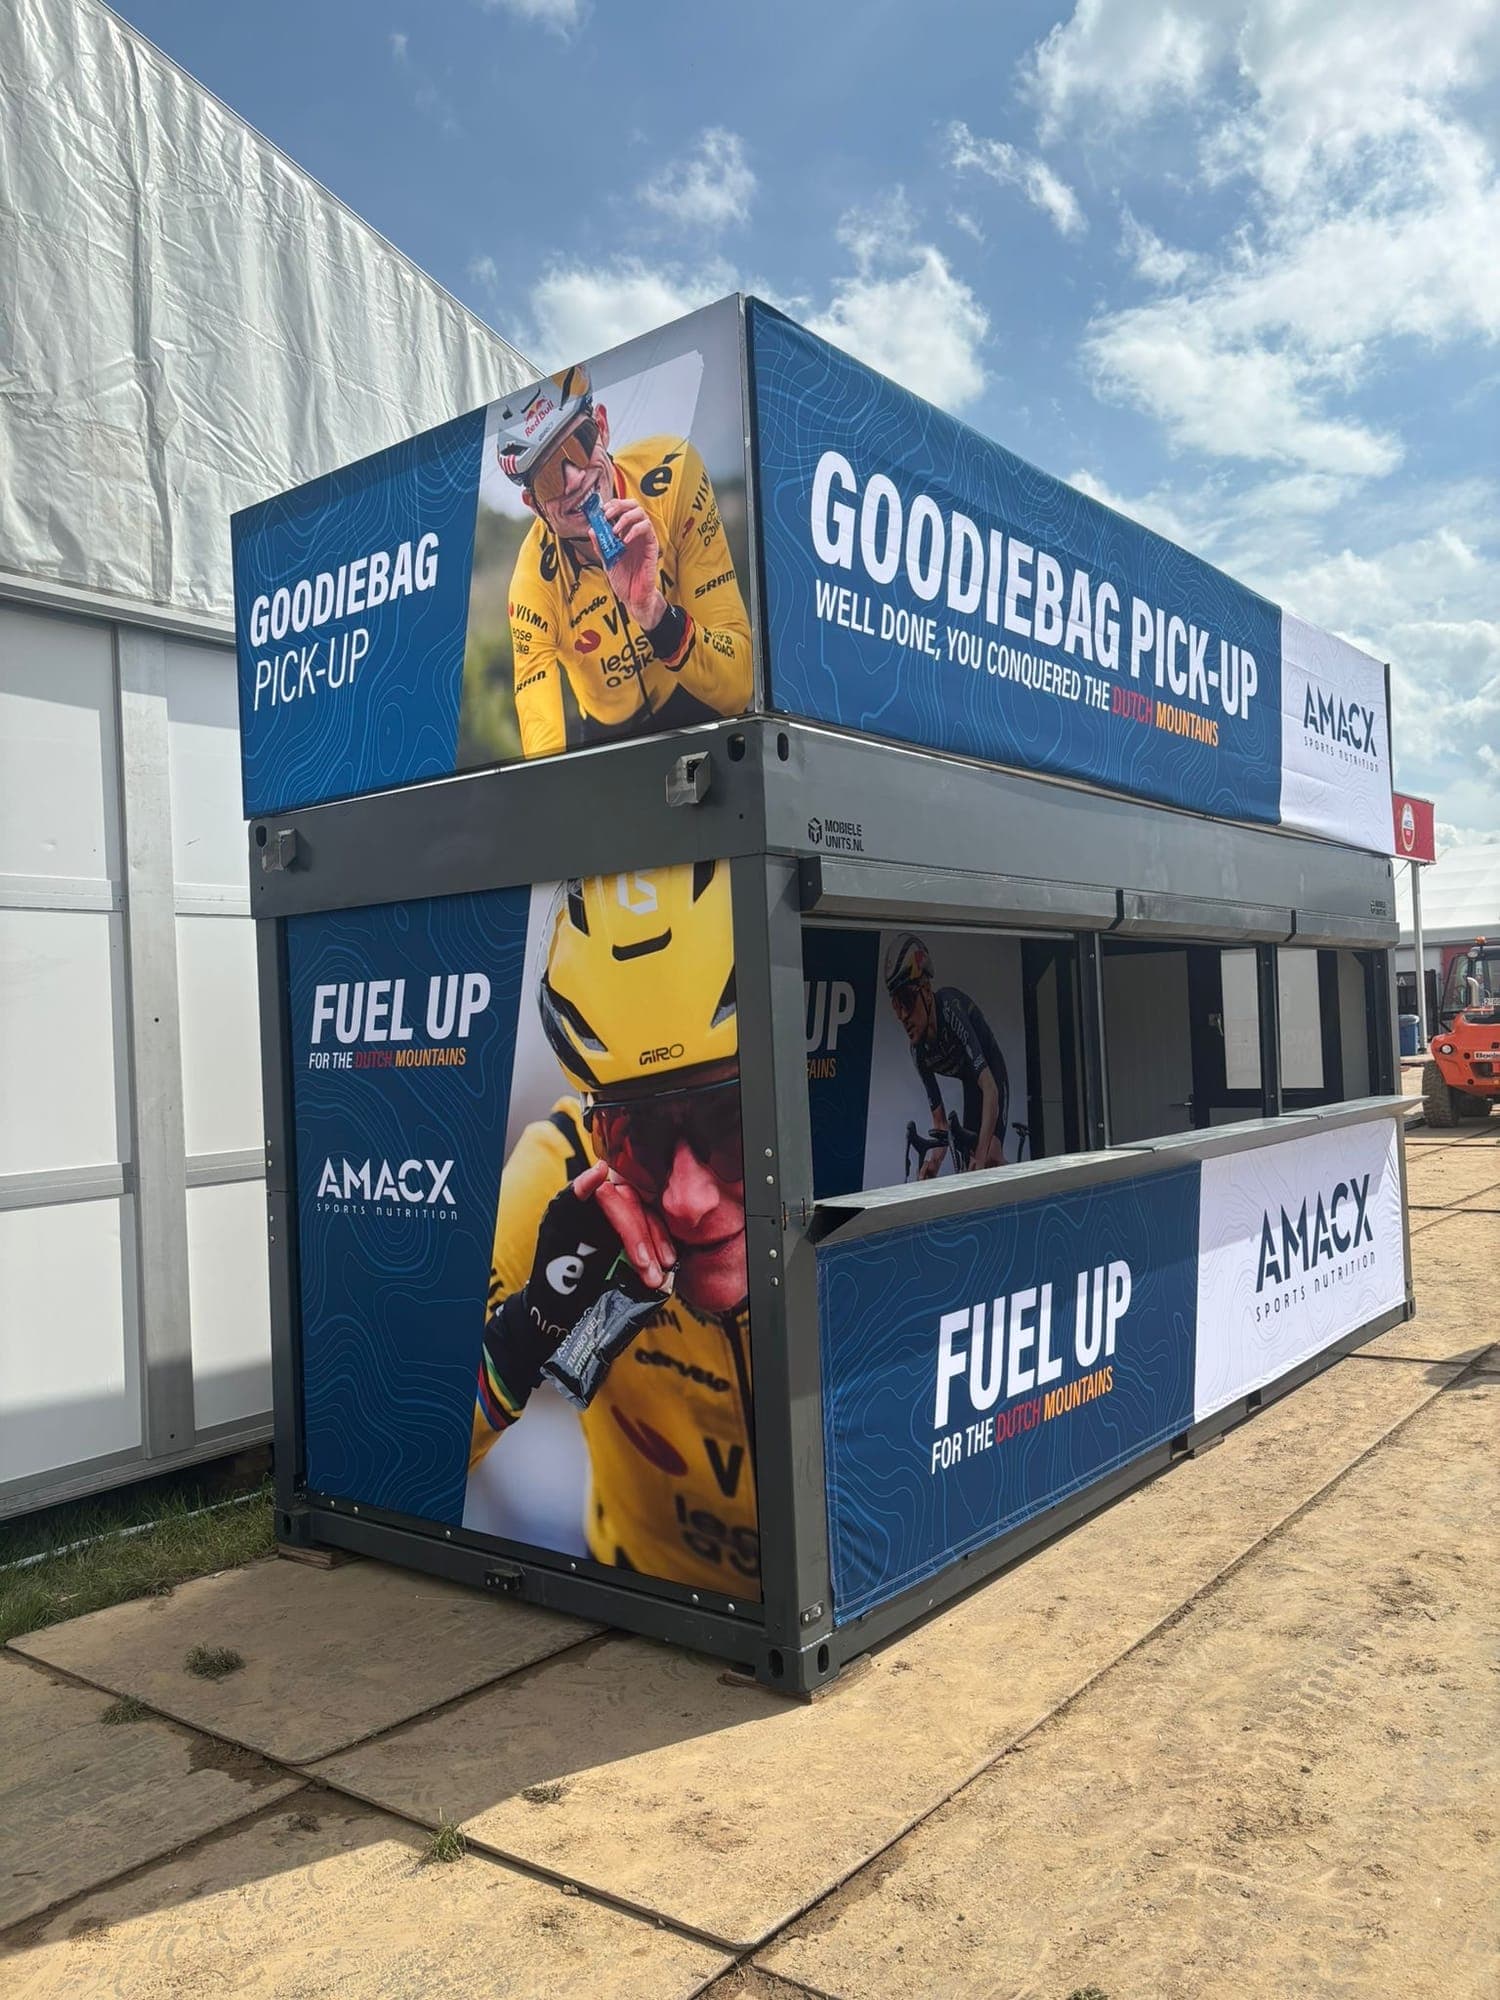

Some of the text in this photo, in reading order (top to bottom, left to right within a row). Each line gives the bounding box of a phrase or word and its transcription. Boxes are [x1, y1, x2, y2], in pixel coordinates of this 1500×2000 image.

[692, 471, 709, 511] VISM
[251, 532, 439, 647] GOODIEBAG
[694, 569, 735, 599] SRAM
[811, 450, 1258, 720] GOODIEBAG PICK-UP
[516, 603, 549, 633] VISMA
[254, 628, 369, 711] PICK-UP
[600, 634, 650, 675] leas
[815, 579, 1219, 748] WELL DONE, YOU CONQUERED THE DUTCH MOUNTAINS
[1303, 681, 1377, 757] AMACX
[1304, 736, 1335, 757] SPORTS
[825, 819, 862, 837] MOBIELE
[825, 835, 864, 852] UNITS.NL
[311, 972, 491, 1044] FUEL UP
[804, 981, 856, 1054] UP
[309, 1047, 467, 1069] FOR THE DUTCH MOUNTAINS
[639, 1043, 684, 1066] GIRO
[317, 1156, 456, 1205] AMACX
[316, 1203, 365, 1215] SPORTS
[1256, 1173, 1373, 1293] AMACX
[1256, 1285, 1306, 1322] SPORTS
[566, 1334, 588, 1369] TURBO
[586, 1316, 600, 1337] GEL
[574, 1340, 597, 1375] CITRUS
[934, 1259, 1132, 1430] FUEL UP
[931, 1365, 1113, 1475] FOR THE DUTCH MOUNTAINS
